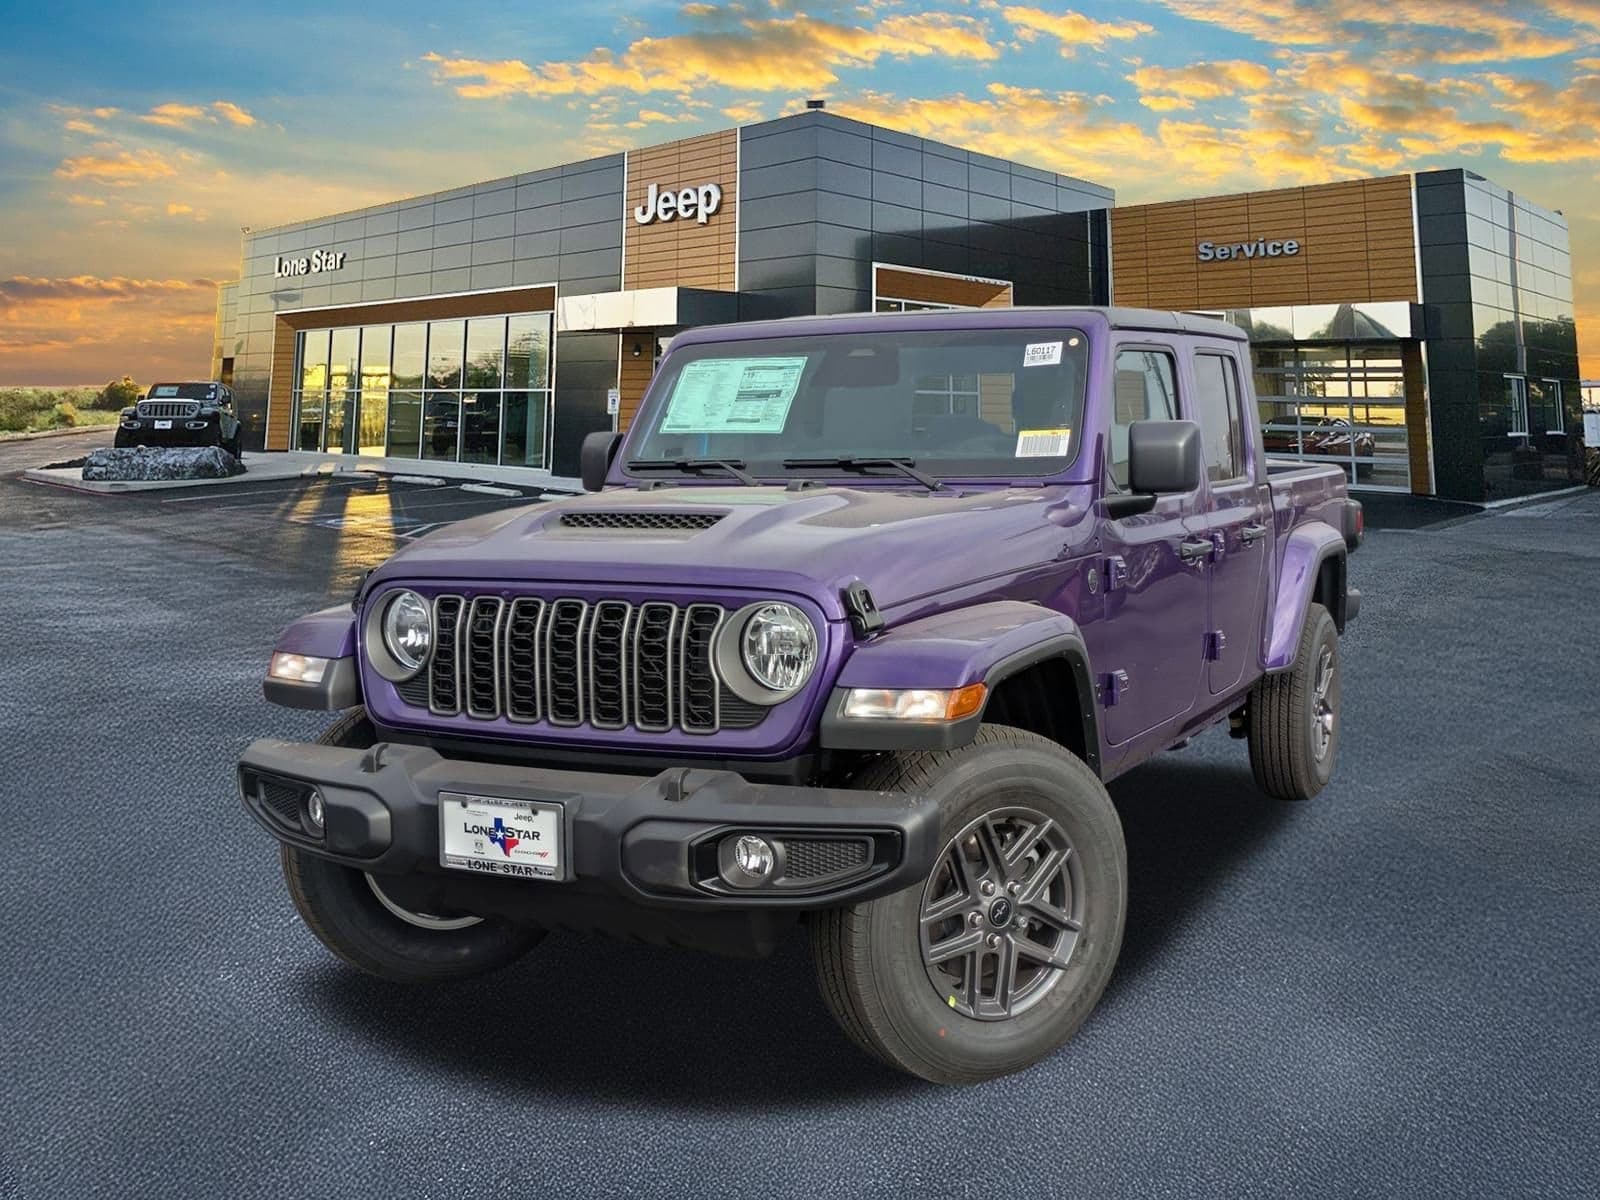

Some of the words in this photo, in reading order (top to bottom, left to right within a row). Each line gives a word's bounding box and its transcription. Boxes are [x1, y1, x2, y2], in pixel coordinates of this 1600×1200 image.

[634, 183, 722, 225] Jeep
[1198, 236, 1299, 262] Service
[274, 256, 309, 279] Lone
[311, 249, 345, 273] Star
[504, 826, 541, 841] STAR
[467, 859, 497, 872] LONE
[503, 863, 534, 876] STAR
